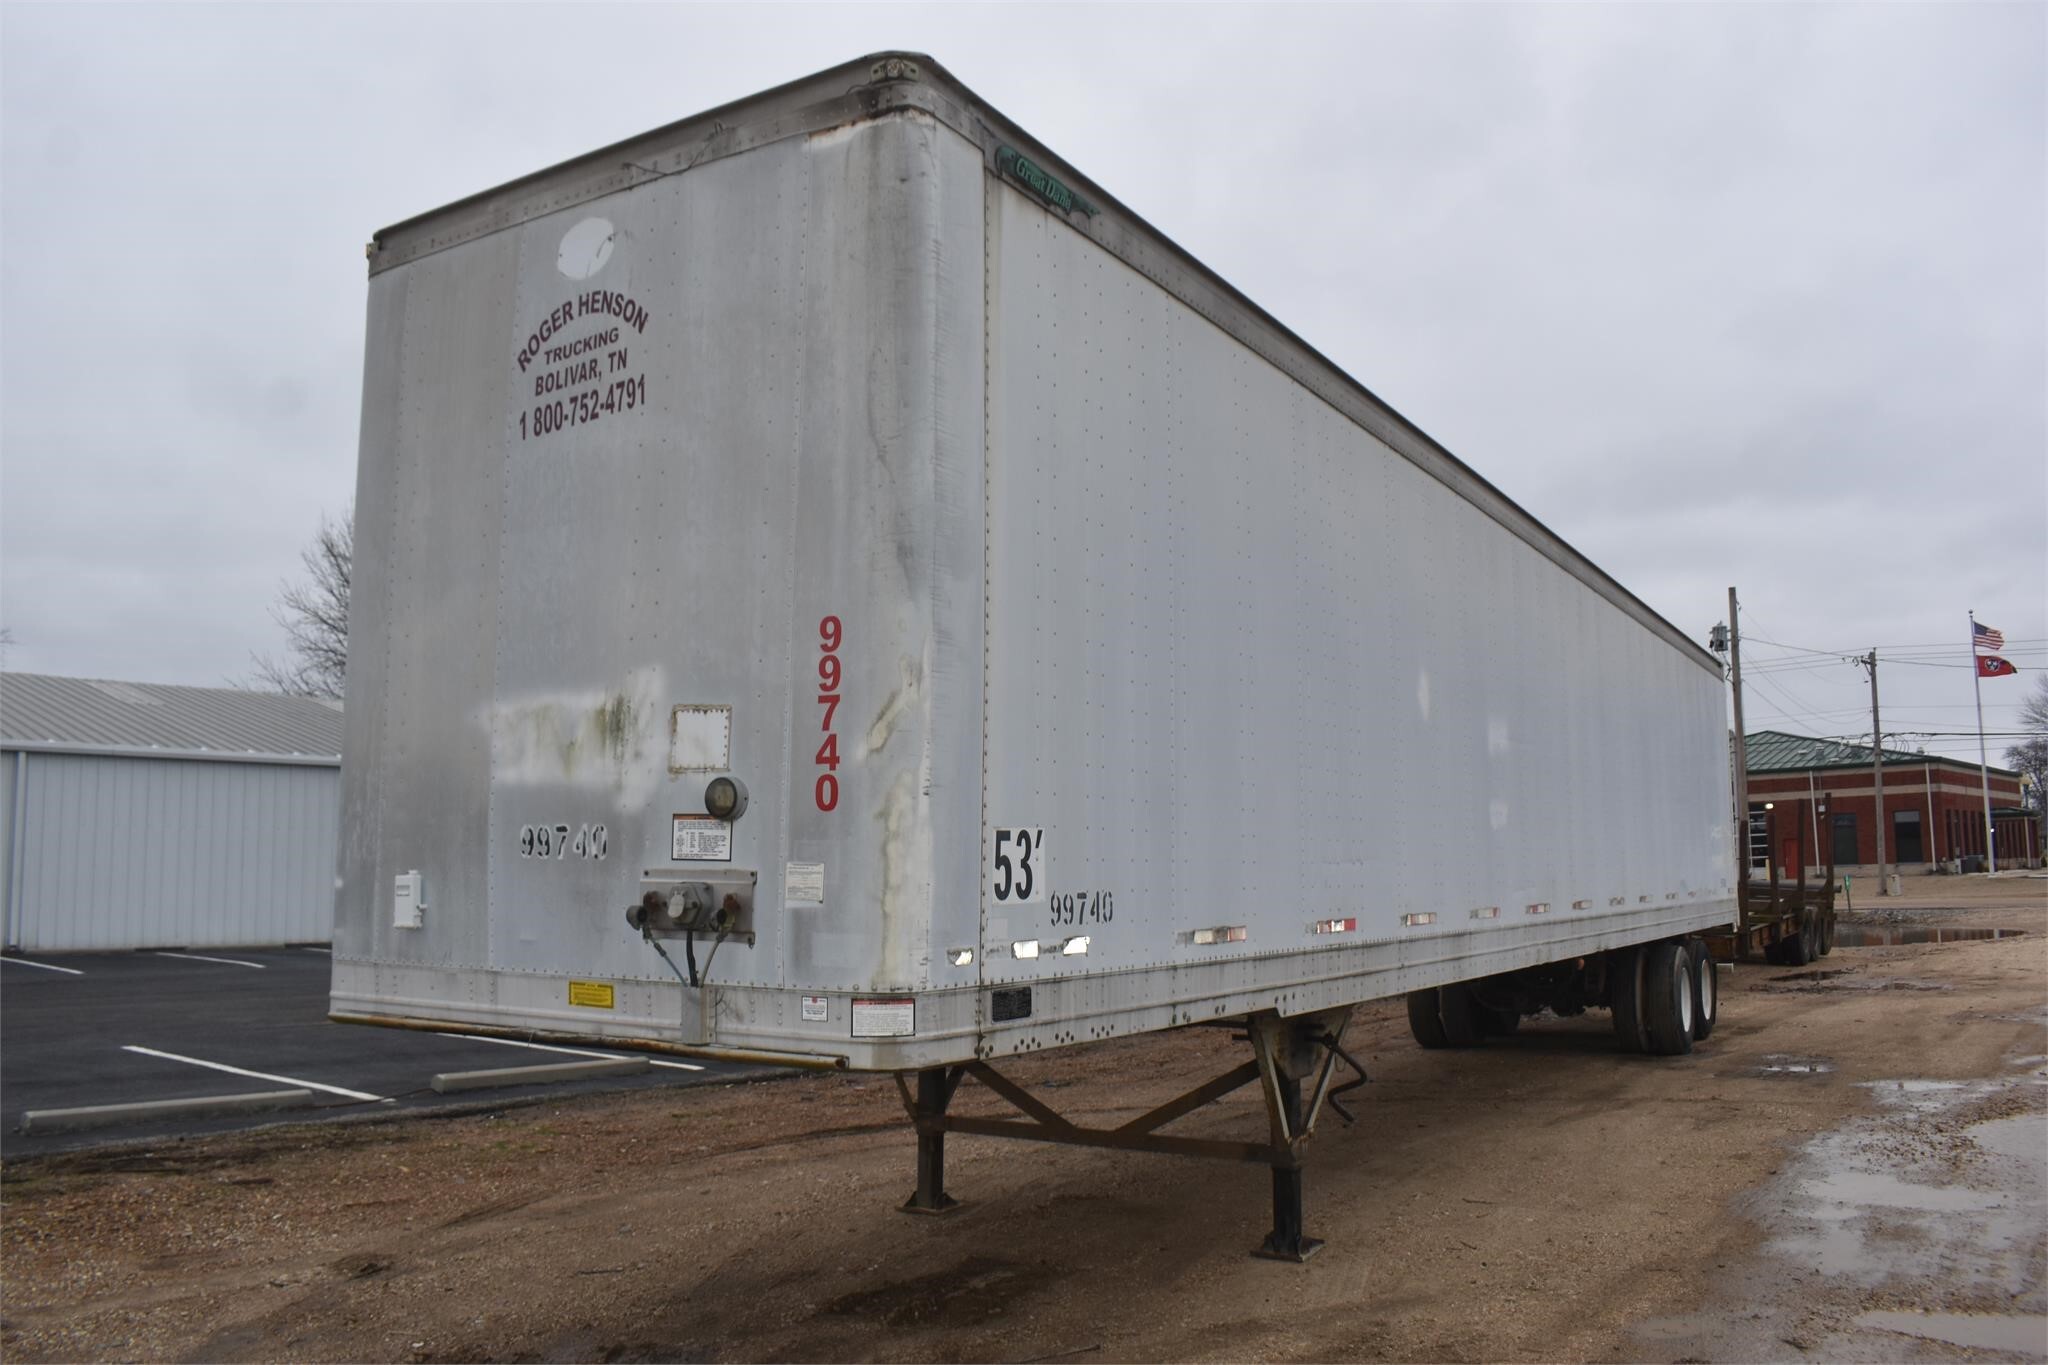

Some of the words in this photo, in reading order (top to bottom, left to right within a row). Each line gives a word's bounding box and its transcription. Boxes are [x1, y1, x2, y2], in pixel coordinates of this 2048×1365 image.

[1016, 158, 1047, 193] Great
[517, 301, 574, 373] ROGER
[578, 290, 649, 334] HENSON
[544, 327, 619, 365] TRUCKING
[535, 358, 602, 396] BOLIVAR,
[608, 347, 628, 373] TN
[519, 410, 527, 440] 1
[533, 373, 645, 437] 800-752-4791
[815, 615, 842, 812] 99740
[521, 825, 608, 859] 99740
[994, 829, 1043, 900] 53'
[1050, 891, 1113, 926] 99740
